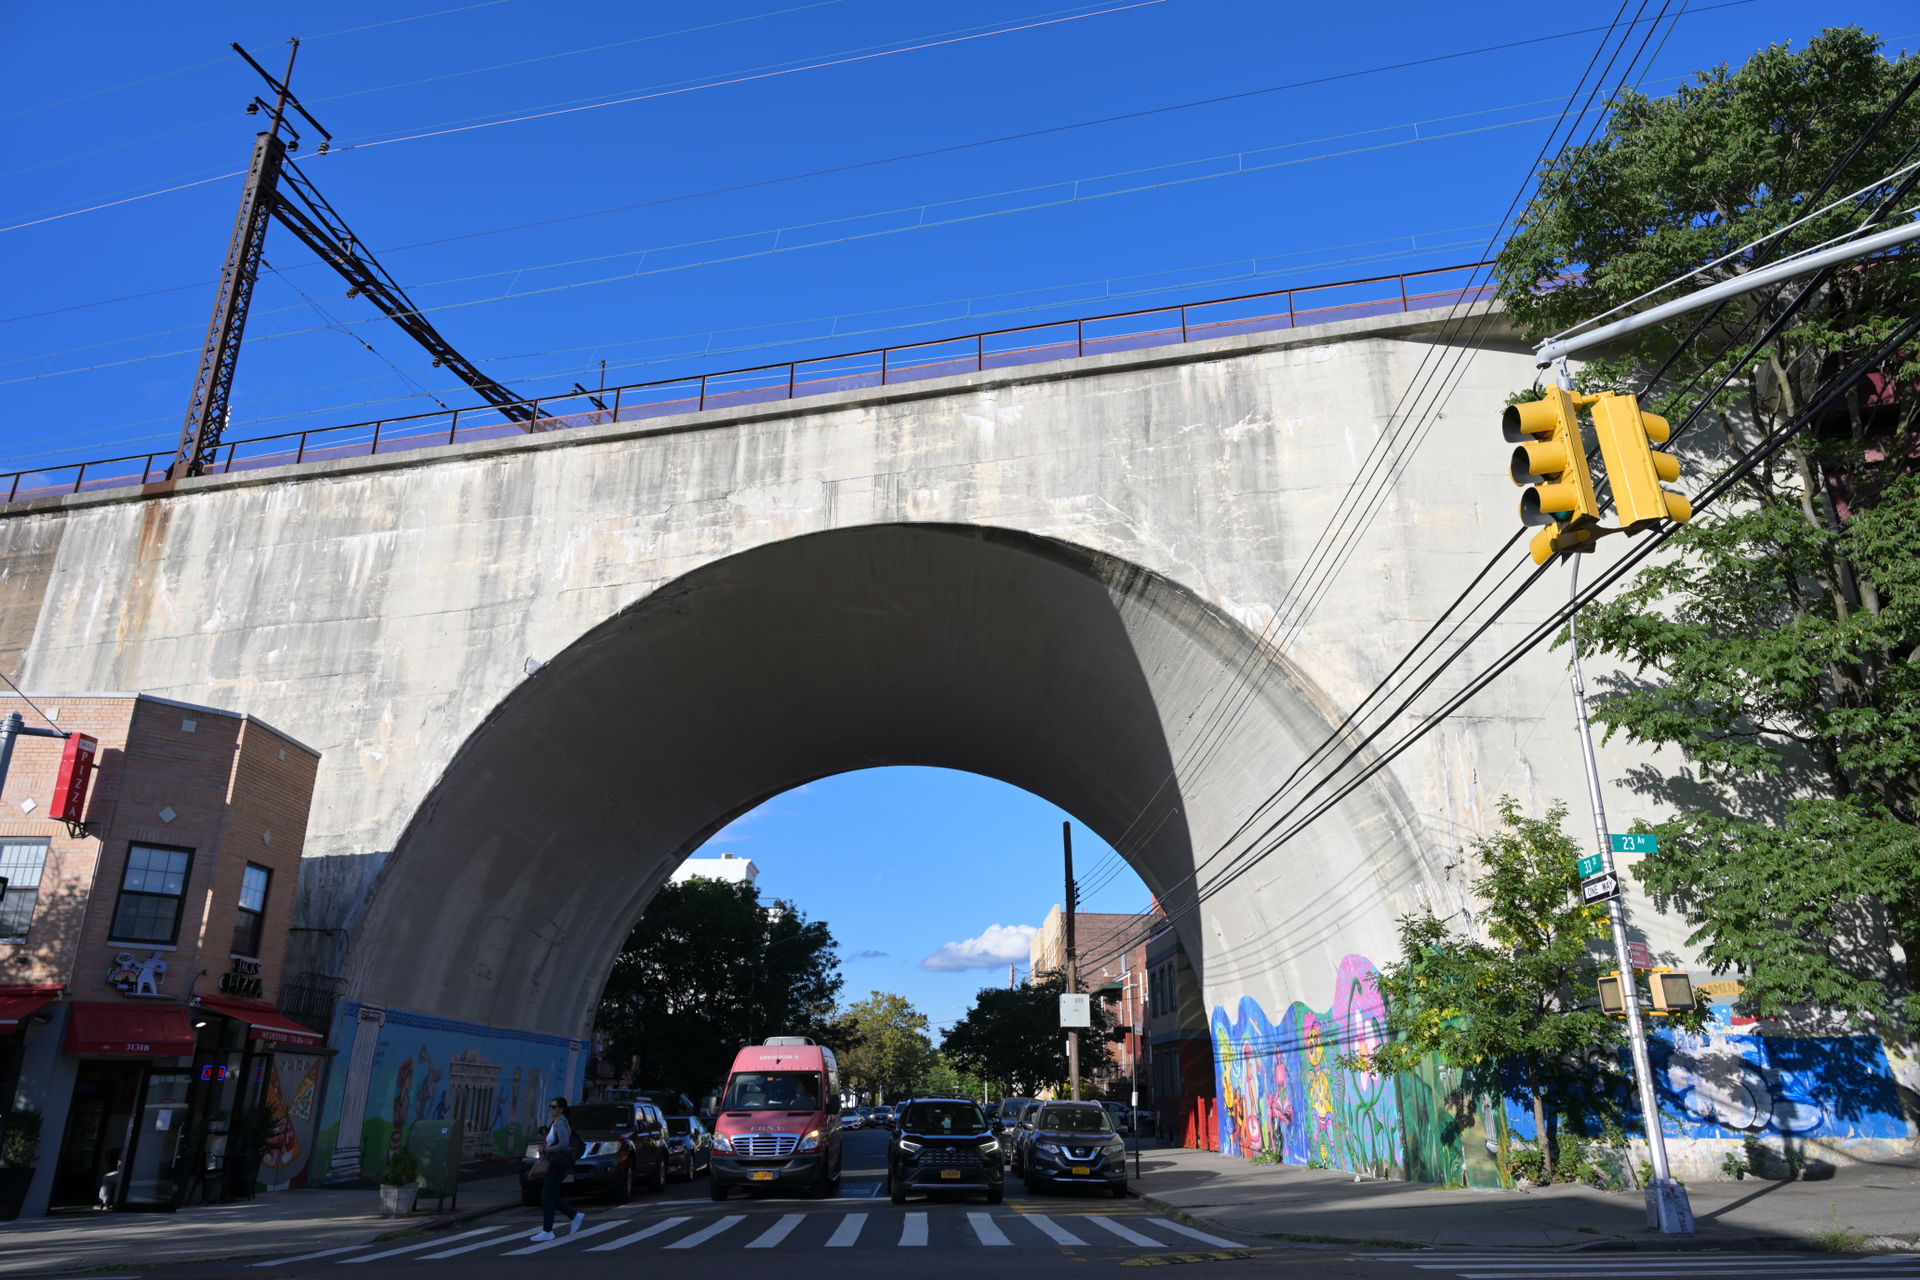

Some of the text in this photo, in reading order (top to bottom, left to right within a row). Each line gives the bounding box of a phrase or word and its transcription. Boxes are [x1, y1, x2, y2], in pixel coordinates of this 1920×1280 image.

[68, 751, 88, 817] PIZZA
[1622, 835, 1646, 851] 23 Av
[1583, 860, 1593, 875] 33
[1587, 878, 1614, 897] ONE WAY
